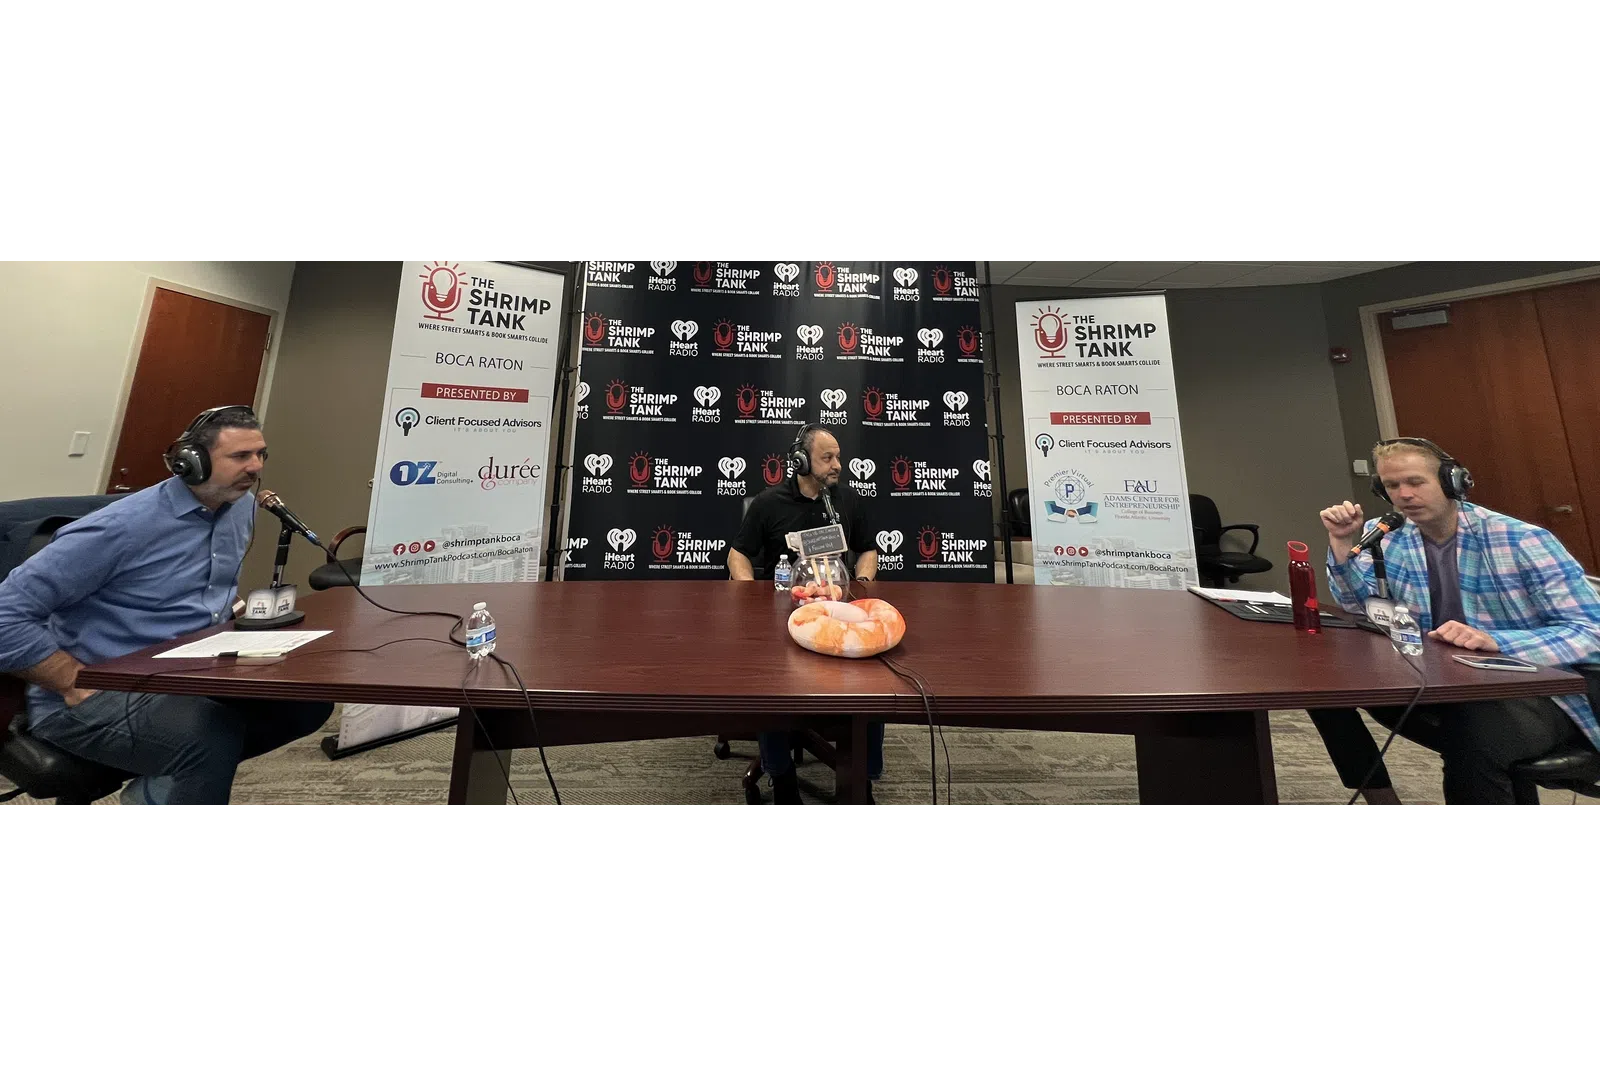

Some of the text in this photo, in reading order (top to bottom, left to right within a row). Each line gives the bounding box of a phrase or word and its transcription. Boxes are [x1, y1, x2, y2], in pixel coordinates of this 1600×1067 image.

[588, 261, 635, 272] SHRIMP
[588, 271, 620, 282] TANK
[716, 268, 760, 280] SHRIMP
[837, 273, 880, 284] SHRIMP
[471, 276, 494, 289] THE
[649, 276, 676, 284] iHeart
[715, 278, 747, 289] TANK
[773, 282, 799, 291] iHeart
[837, 283, 867, 293] TANK
[469, 289, 551, 314] SHRIMP
[467, 308, 526, 330] TANK
[1073, 315, 1095, 324] THE
[418, 323, 440, 331] WHERE
[441, 325, 461, 333] STREET
[463, 328, 485, 337] SMARTS
[608, 326, 655, 337] SHRIMP
[1075, 323, 1156, 340] SHRIMP
[608, 337, 640, 348] TANK
[736, 332, 782, 343] SHRIMP
[860, 335, 904, 346] SHRIMP
[670, 341, 698, 350] iHeart
[736, 342, 769, 352] TANK
[796, 346, 823, 354] iHeart
[860, 345, 890, 356] TANK
[1075, 341, 1133, 358] TANK
[669, 348, 698, 357] RADIO
[918, 348, 944, 357] iHeart
[435, 352, 523, 371] BOCA RATON
[436, 387, 516, 400] PRESENTED BY
[1056, 384, 1138, 396] BOCA RATON
[630, 393, 677, 405] SHRIMP
[760, 397, 805, 408] SHRIMP
[630, 404, 662, 415] TANK
[886, 400, 930, 410] SHRIMP
[693, 407, 720, 416] iHeart
[760, 408, 792, 419] TANK
[886, 410, 917, 421] TANK
[425, 415, 542, 428] Client Focused Advisors
[692, 414, 720, 423] RADIO
[1063, 415, 1137, 424] PRESENTED BY
[1059, 440, 1171, 448] Client Focused Advisors
[478, 457, 540, 480] durée
[654, 465, 702, 477] SHRIMP
[915, 468, 959, 479] SHRIMP
[481, 471, 538, 490] & company
[583, 477, 612, 486] iHeart
[654, 477, 688, 488] TANK
[1044, 468, 1094, 488] Premier Virtual
[582, 485, 612, 494] RADIO
[718, 480, 746, 488] iHeart
[849, 480, 876, 490] iHeart
[915, 479, 946, 490] TANK
[1124, 480, 1157, 493] FAU
[717, 487, 746, 496] RADIO
[1065, 484, 1074, 498] P
[1104, 502, 1180, 510] ENTREPRENEURSHIP
[442, 535, 521, 549] @shrimptankboca
[677, 540, 726, 551] SHRIMP
[941, 540, 987, 551] SHRIMP
[374, 546, 533, 570] www.ShrimpTankPodcast.com/BocaRaton
[604, 552, 635, 562] iHeart
[676, 552, 710, 563] TANK
[878, 553, 903, 562] Heart
[942, 551, 973, 562] TANK
[1095, 549, 1171, 560] @shrimptankboca
[604, 561, 635, 570] RADIO
[1043, 560, 1188, 573] www.ShrimpTankPodcast.com/BocaRaton
